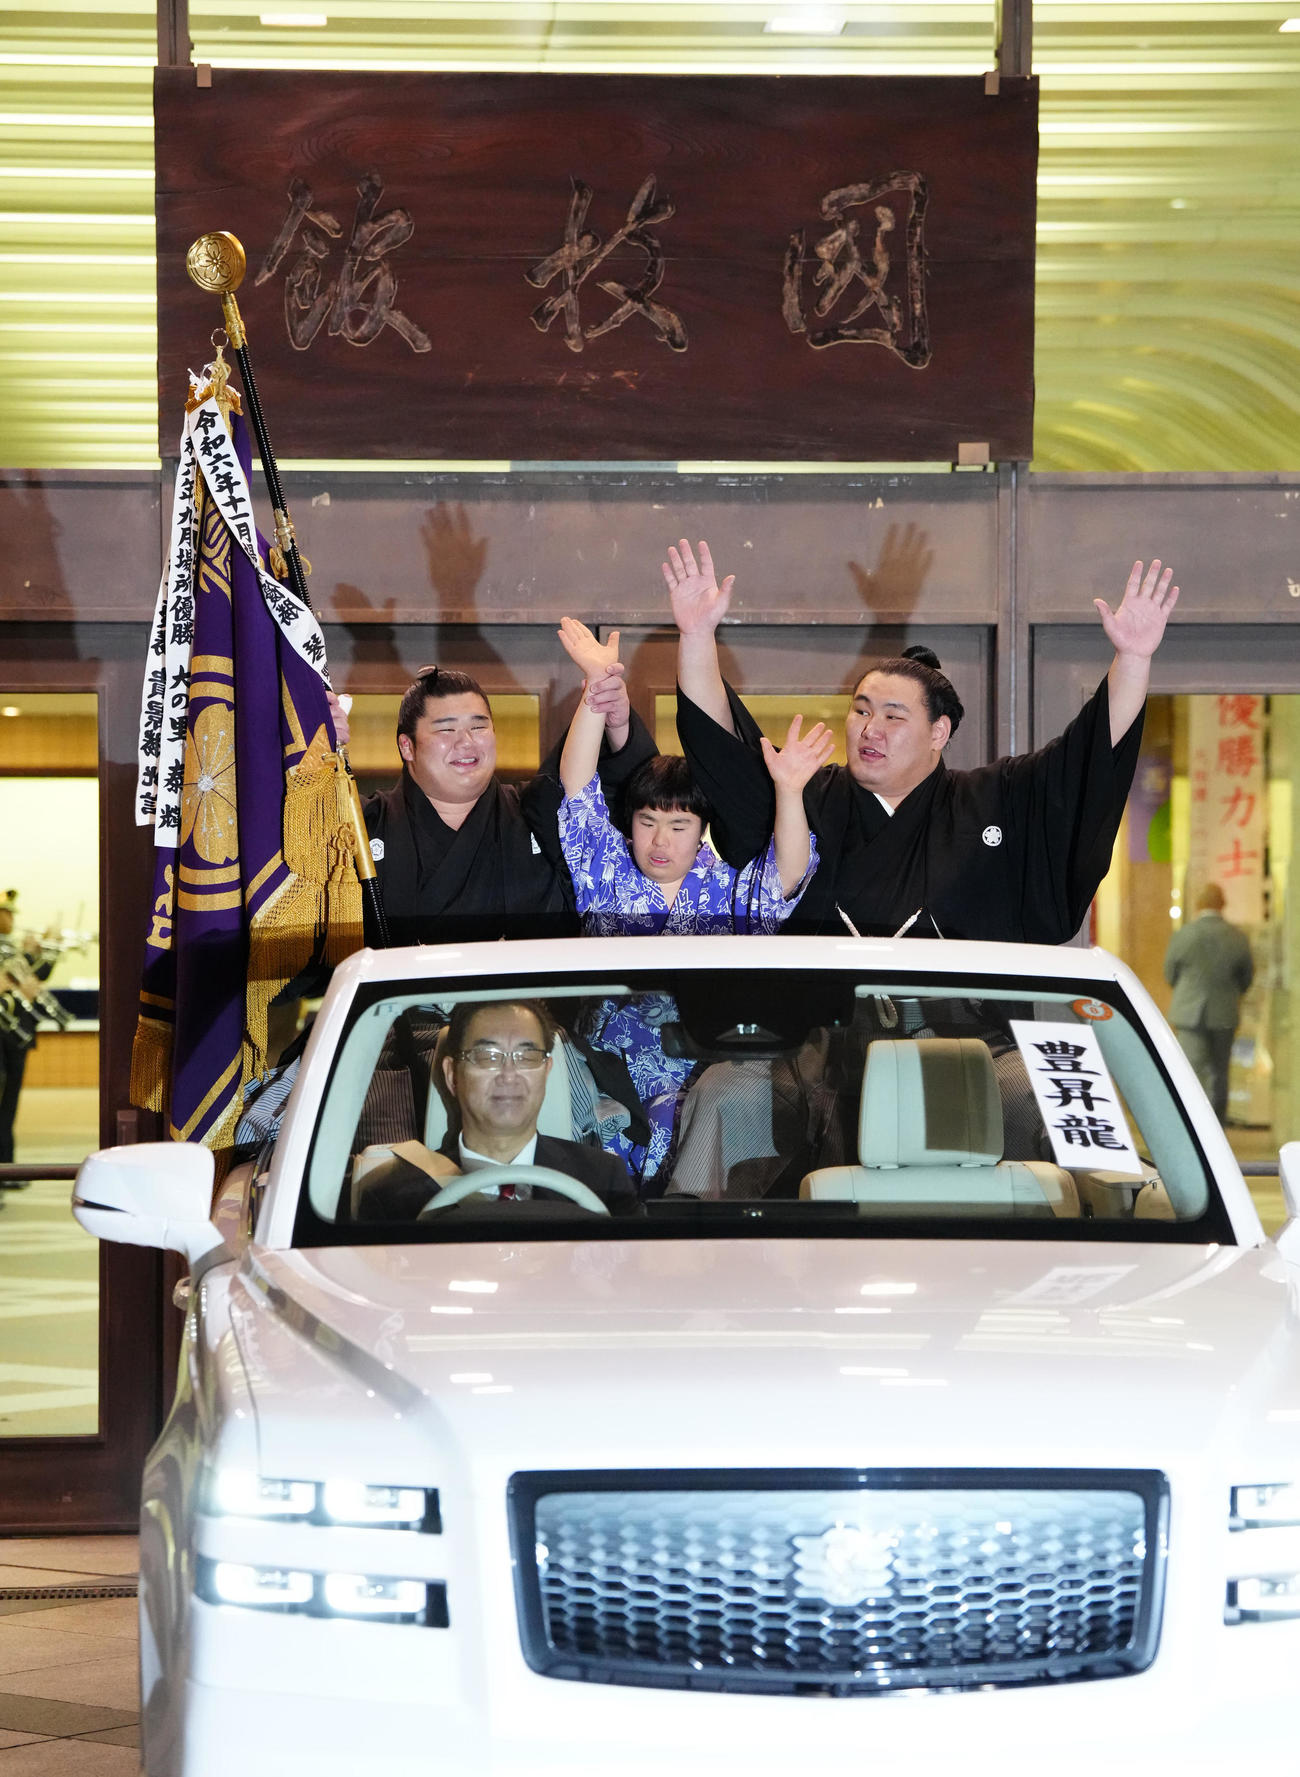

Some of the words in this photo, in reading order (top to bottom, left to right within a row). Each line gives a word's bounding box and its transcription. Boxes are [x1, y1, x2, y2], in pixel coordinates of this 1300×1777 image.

[194, 409, 261, 570] 令和六年十一月場
[166, 665, 191, 742] 大の里
[1215, 694, 1261, 879] 優勝力士
[1030, 1040, 1130, 1150] 豊昇龍
